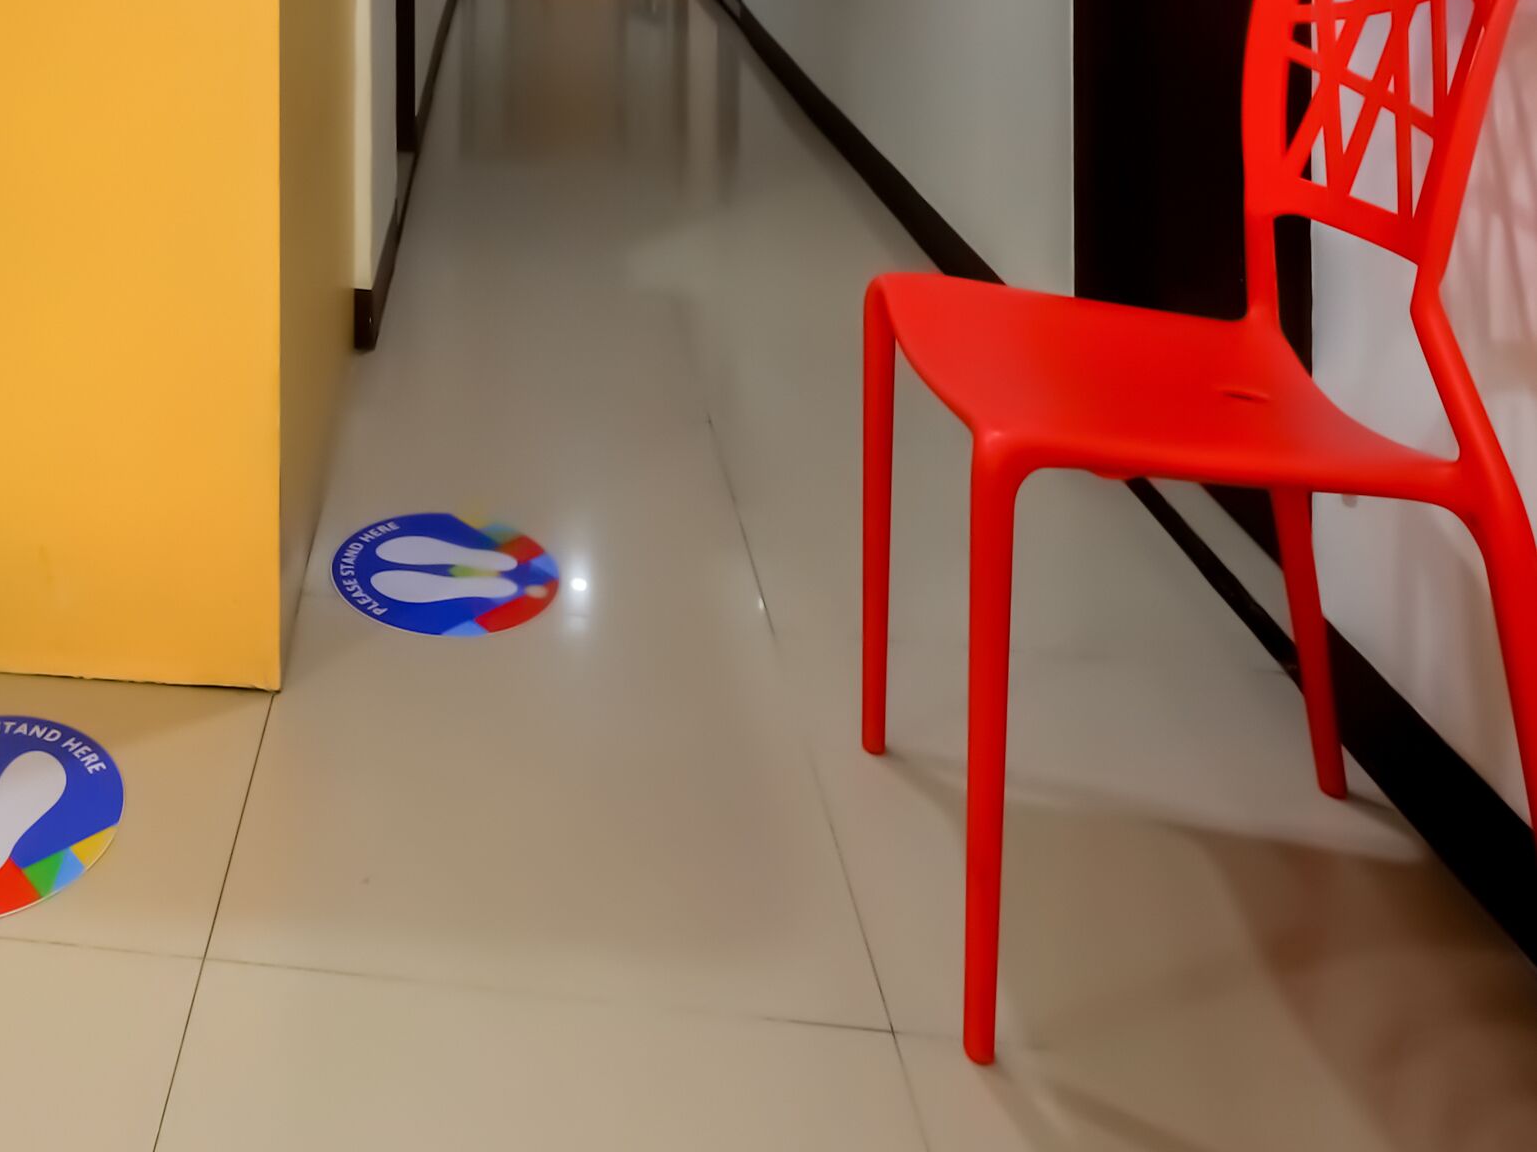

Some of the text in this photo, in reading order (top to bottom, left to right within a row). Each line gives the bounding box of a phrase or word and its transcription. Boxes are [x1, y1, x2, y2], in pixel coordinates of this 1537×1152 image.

[339, 521, 399, 616] PLEASE STAND HERE
[61, 736, 108, 775] HERE
